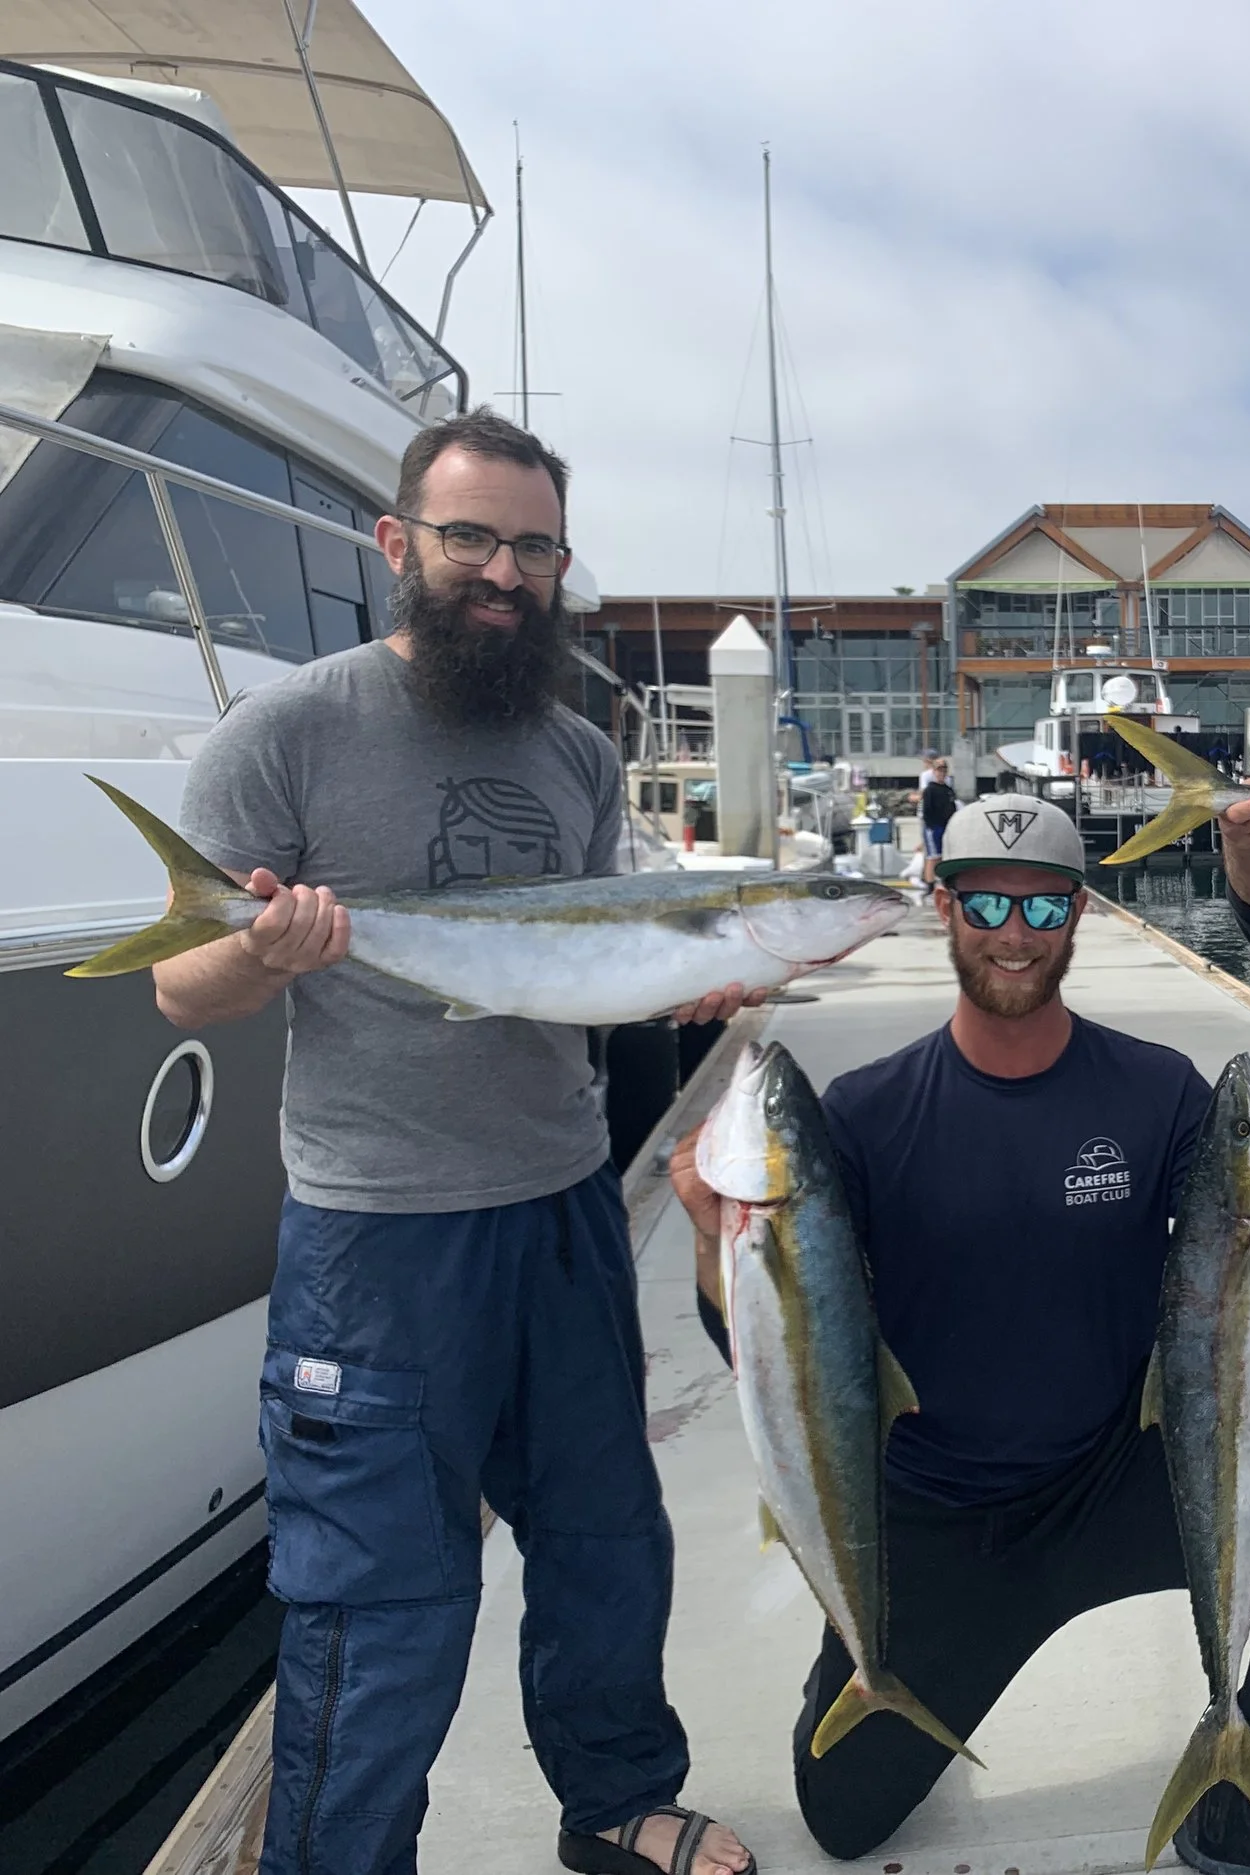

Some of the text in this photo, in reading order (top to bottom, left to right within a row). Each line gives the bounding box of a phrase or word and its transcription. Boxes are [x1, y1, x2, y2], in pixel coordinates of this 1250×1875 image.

[998, 813, 1021, 833] M
[1064, 1171, 1131, 1189] CAREFREE
[1065, 1188, 1131, 1206] BOAT CLUB
